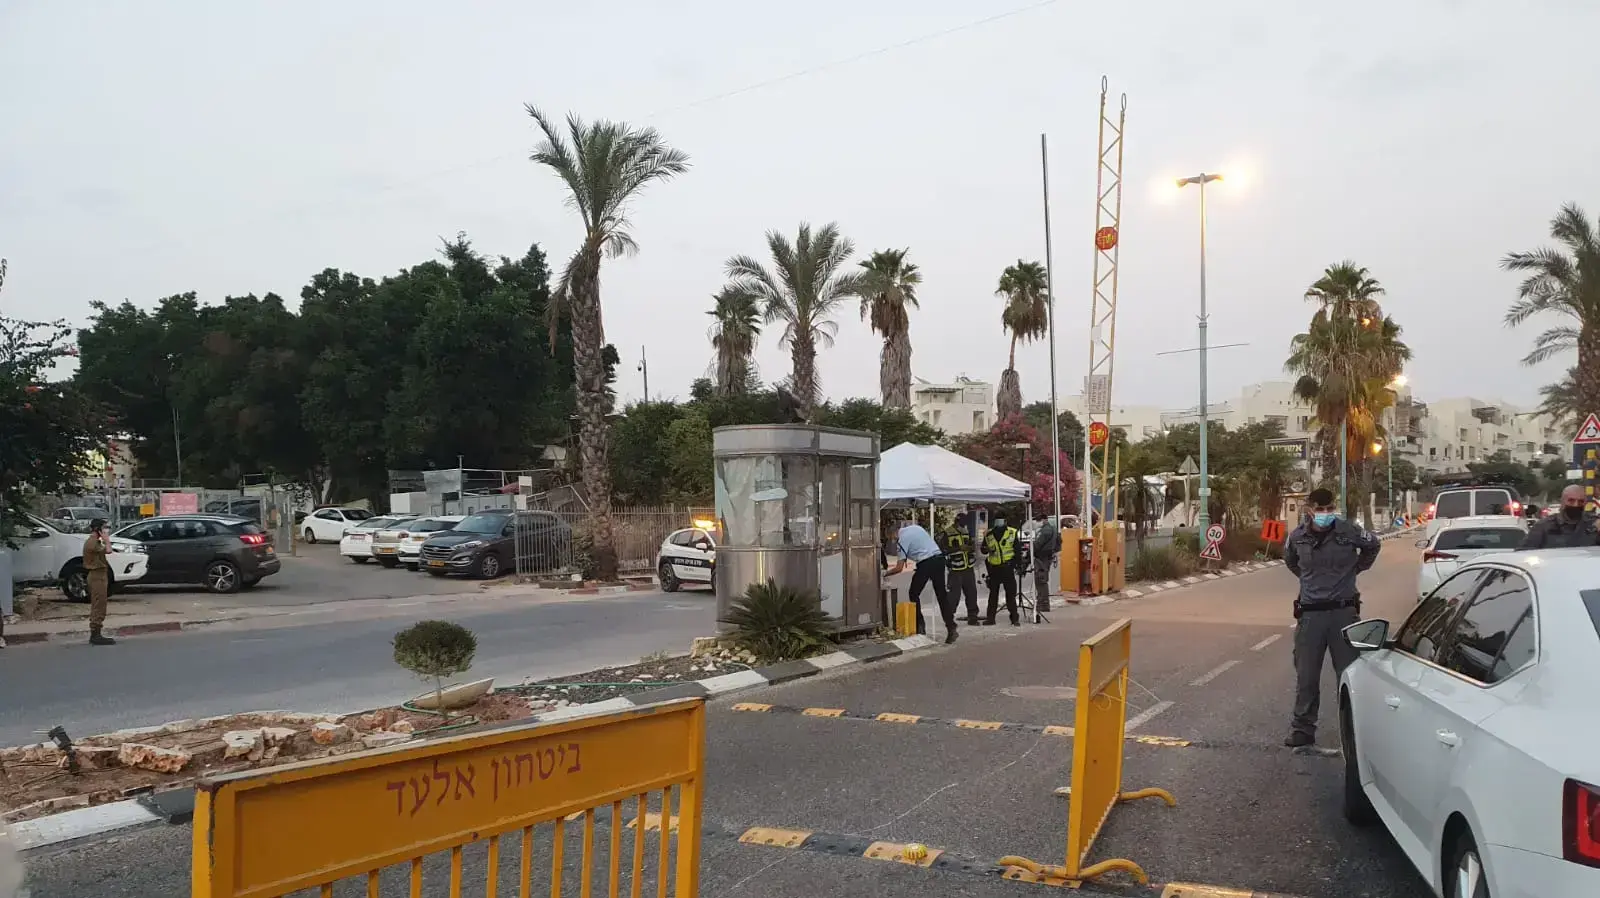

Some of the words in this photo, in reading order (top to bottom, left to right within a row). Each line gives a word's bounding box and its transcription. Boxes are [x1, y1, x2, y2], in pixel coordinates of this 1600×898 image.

[1209, 529, 1222, 539] 30
[386, 760, 476, 819] אלעד
[490, 743, 581, 803] ביטחון
